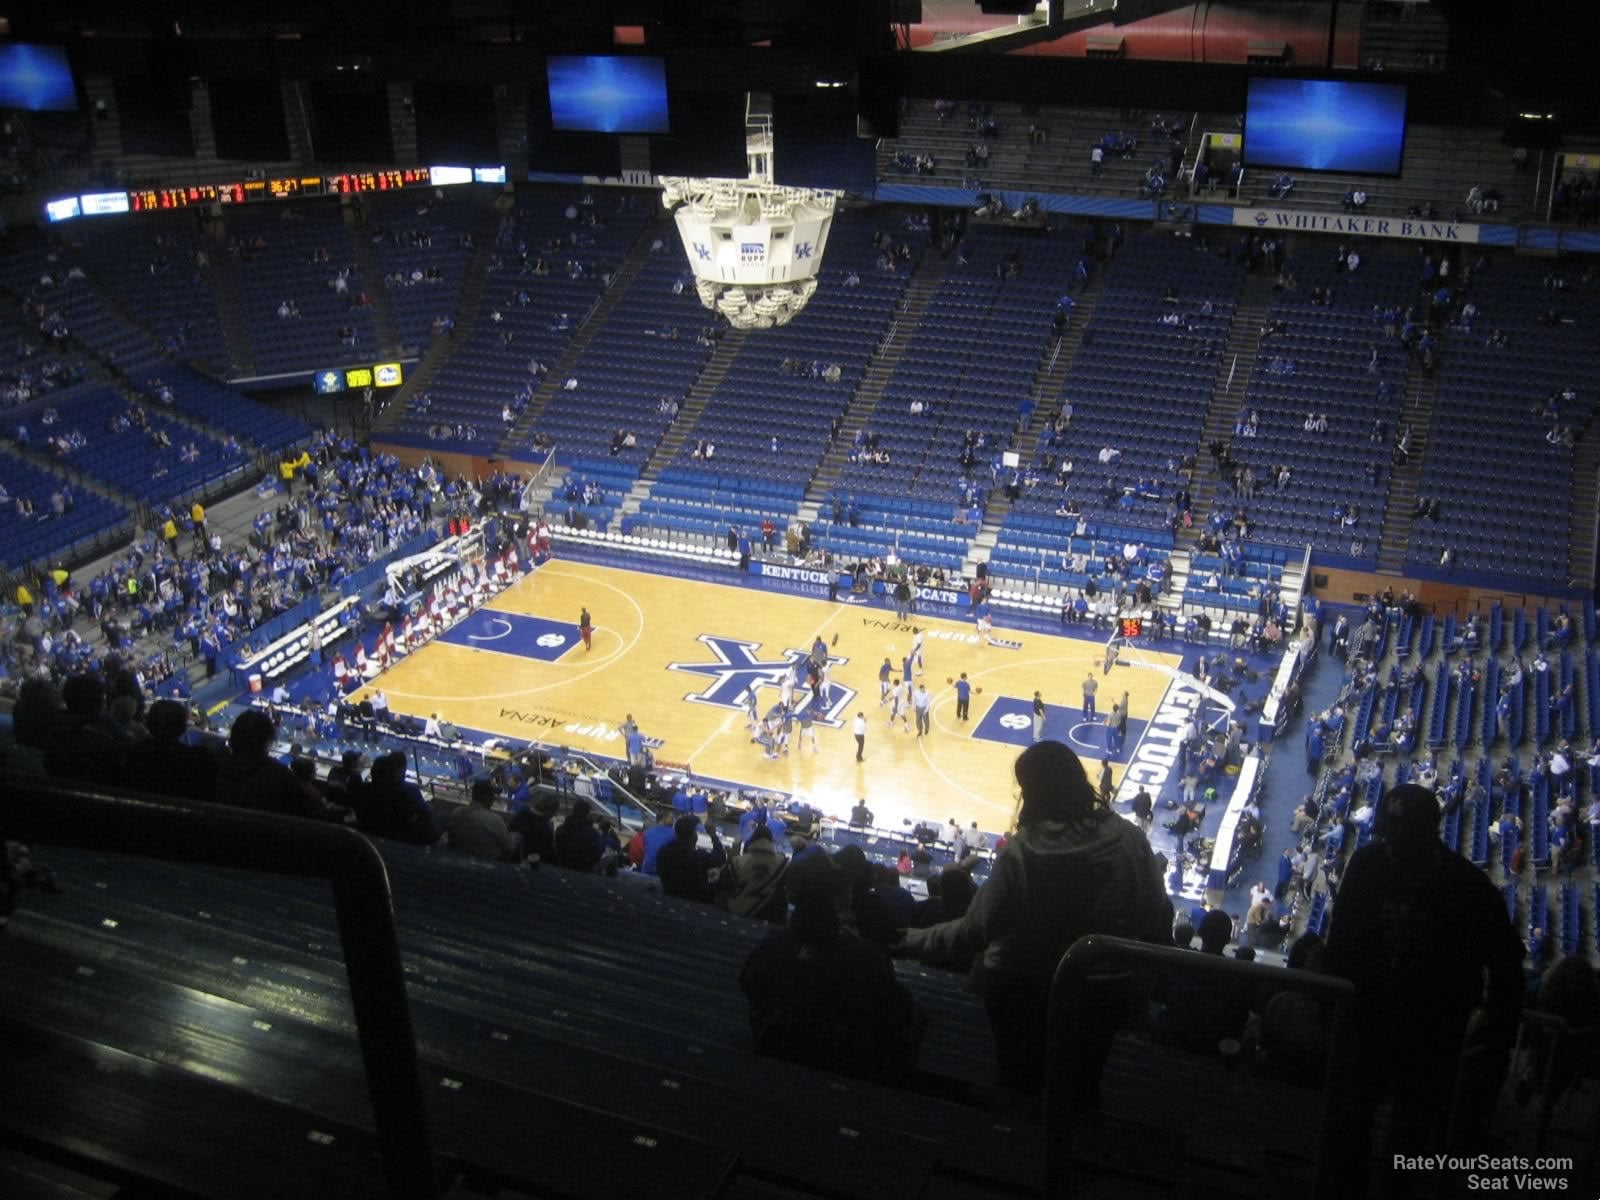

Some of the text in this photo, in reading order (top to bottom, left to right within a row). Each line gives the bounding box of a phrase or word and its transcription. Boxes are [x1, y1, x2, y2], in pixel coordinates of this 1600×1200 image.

[1276, 212, 1461, 239] WHITAKER BANK
[693, 242, 712, 261] UK
[795, 241, 812, 260] UK
[761, 563, 830, 585] KENTUCK
[1124, 624, 1138, 636] 35
[500, 707, 567, 728] ARENA
[564, 722, 620, 741] RUPP
